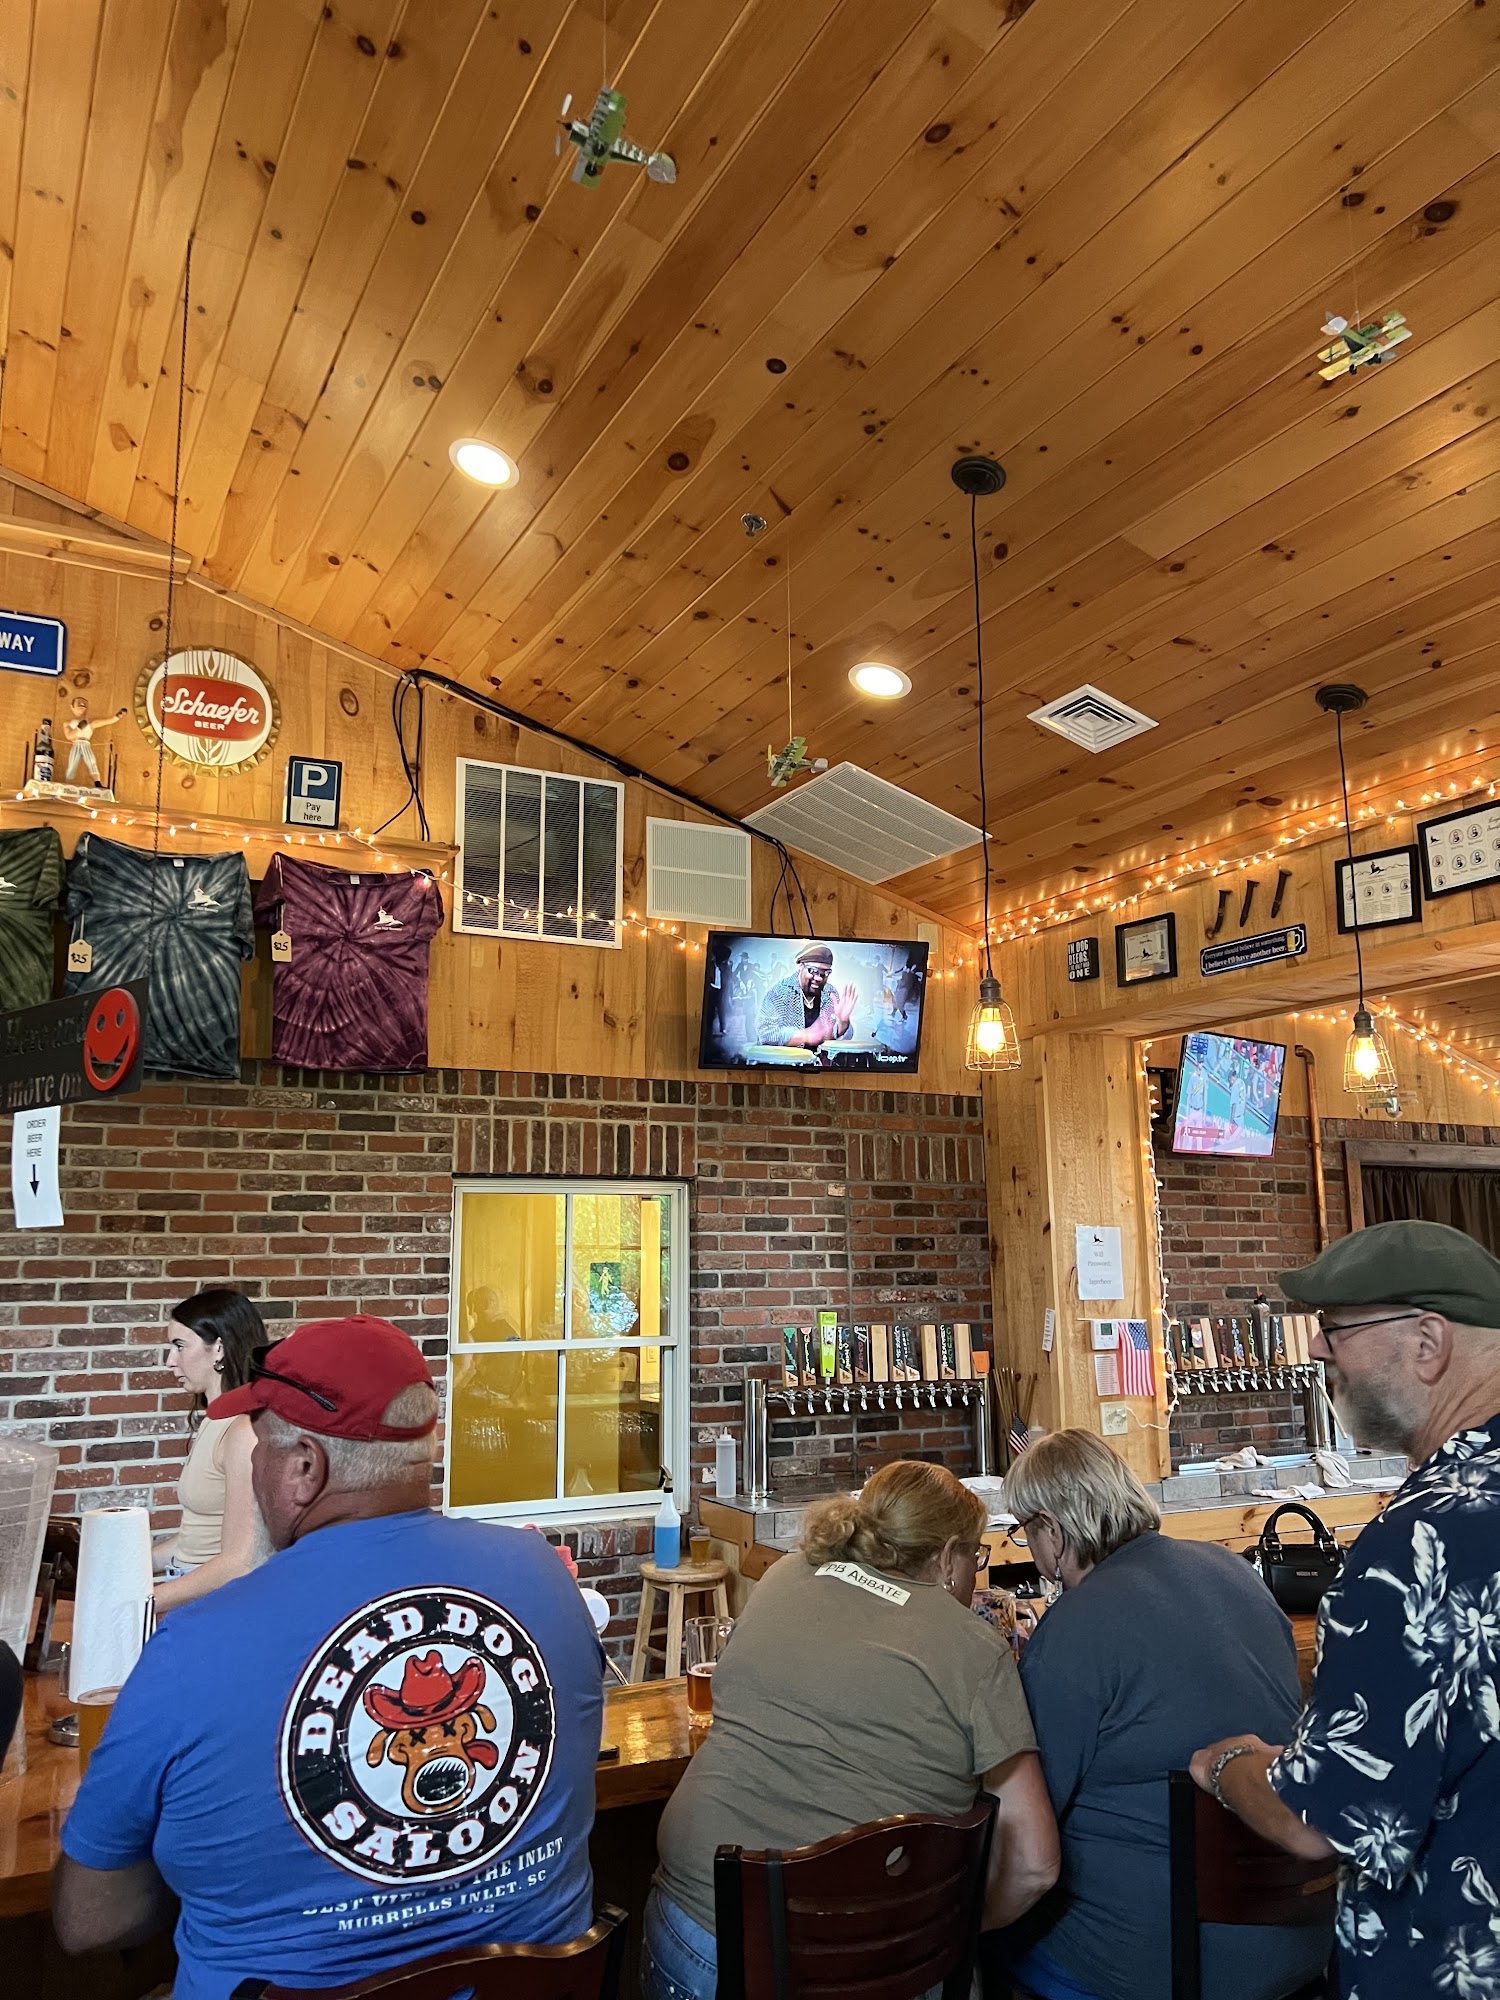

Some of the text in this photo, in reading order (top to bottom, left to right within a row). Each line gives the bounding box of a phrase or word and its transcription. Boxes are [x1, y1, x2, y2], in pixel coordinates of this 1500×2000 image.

[160, 687, 259, 725] Schaefer
[194, 720, 225, 731] BEER
[301, 764, 329, 797] P
[306, 801, 321, 812] Pay
[303, 811, 322, 822] here
[273, 941, 289, 951] $25
[1068, 939, 1089, 955] IN DOG
[71, 953, 88, 963] $25
[1208, 958, 1227, 969] believe
[1235, 953, 1250, 963] have
[1249, 948, 1272, 960] another
[1272, 944, 1287, 954] beer.
[1069, 967, 1091, 980] ONE
[26, 1118, 47, 1129] ORDER
[26, 1133, 43, 1144] BEER
[26, 1147, 43, 1158] HERE
[826, 1563, 902, 1599] PB ABBATE
[298, 1602, 540, 1756] DEAD DOG
[321, 1738, 541, 1868] SALOON
[518, 1836, 564, 1872] INLET
[338, 1898, 452, 1932] MURRELLS
[528, 1869, 547, 1887] SC
